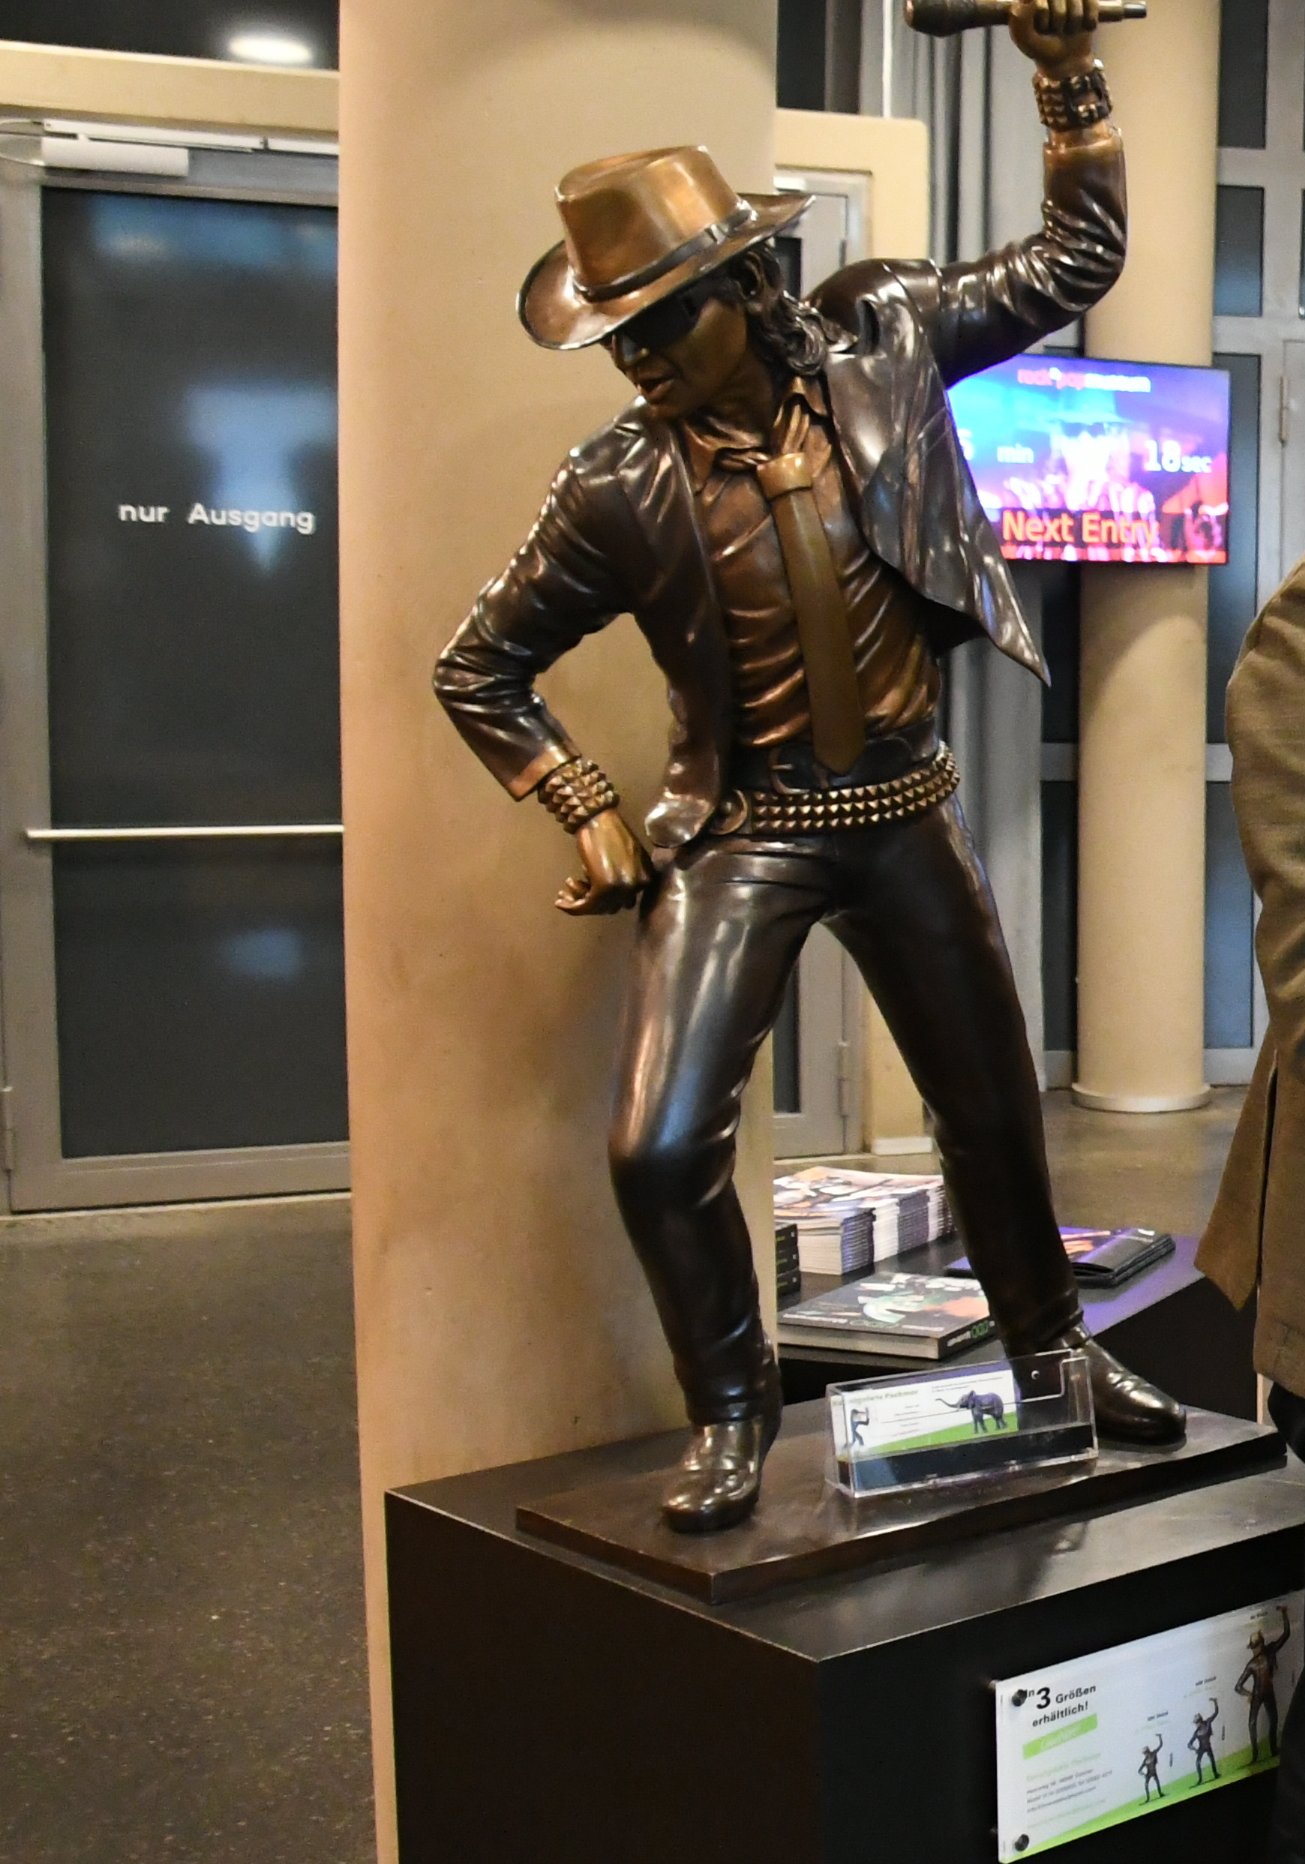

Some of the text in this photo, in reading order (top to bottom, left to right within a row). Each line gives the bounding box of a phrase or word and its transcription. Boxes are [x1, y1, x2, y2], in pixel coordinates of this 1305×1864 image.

[119, 500, 315, 535] nur Ausgang
[1002, 509, 1160, 545] Next Entry
[1036, 1686, 1051, 1710] 3
[1055, 1685, 1097, 1704] Größen
[1032, 1700, 1089, 1728] erhältlich!
